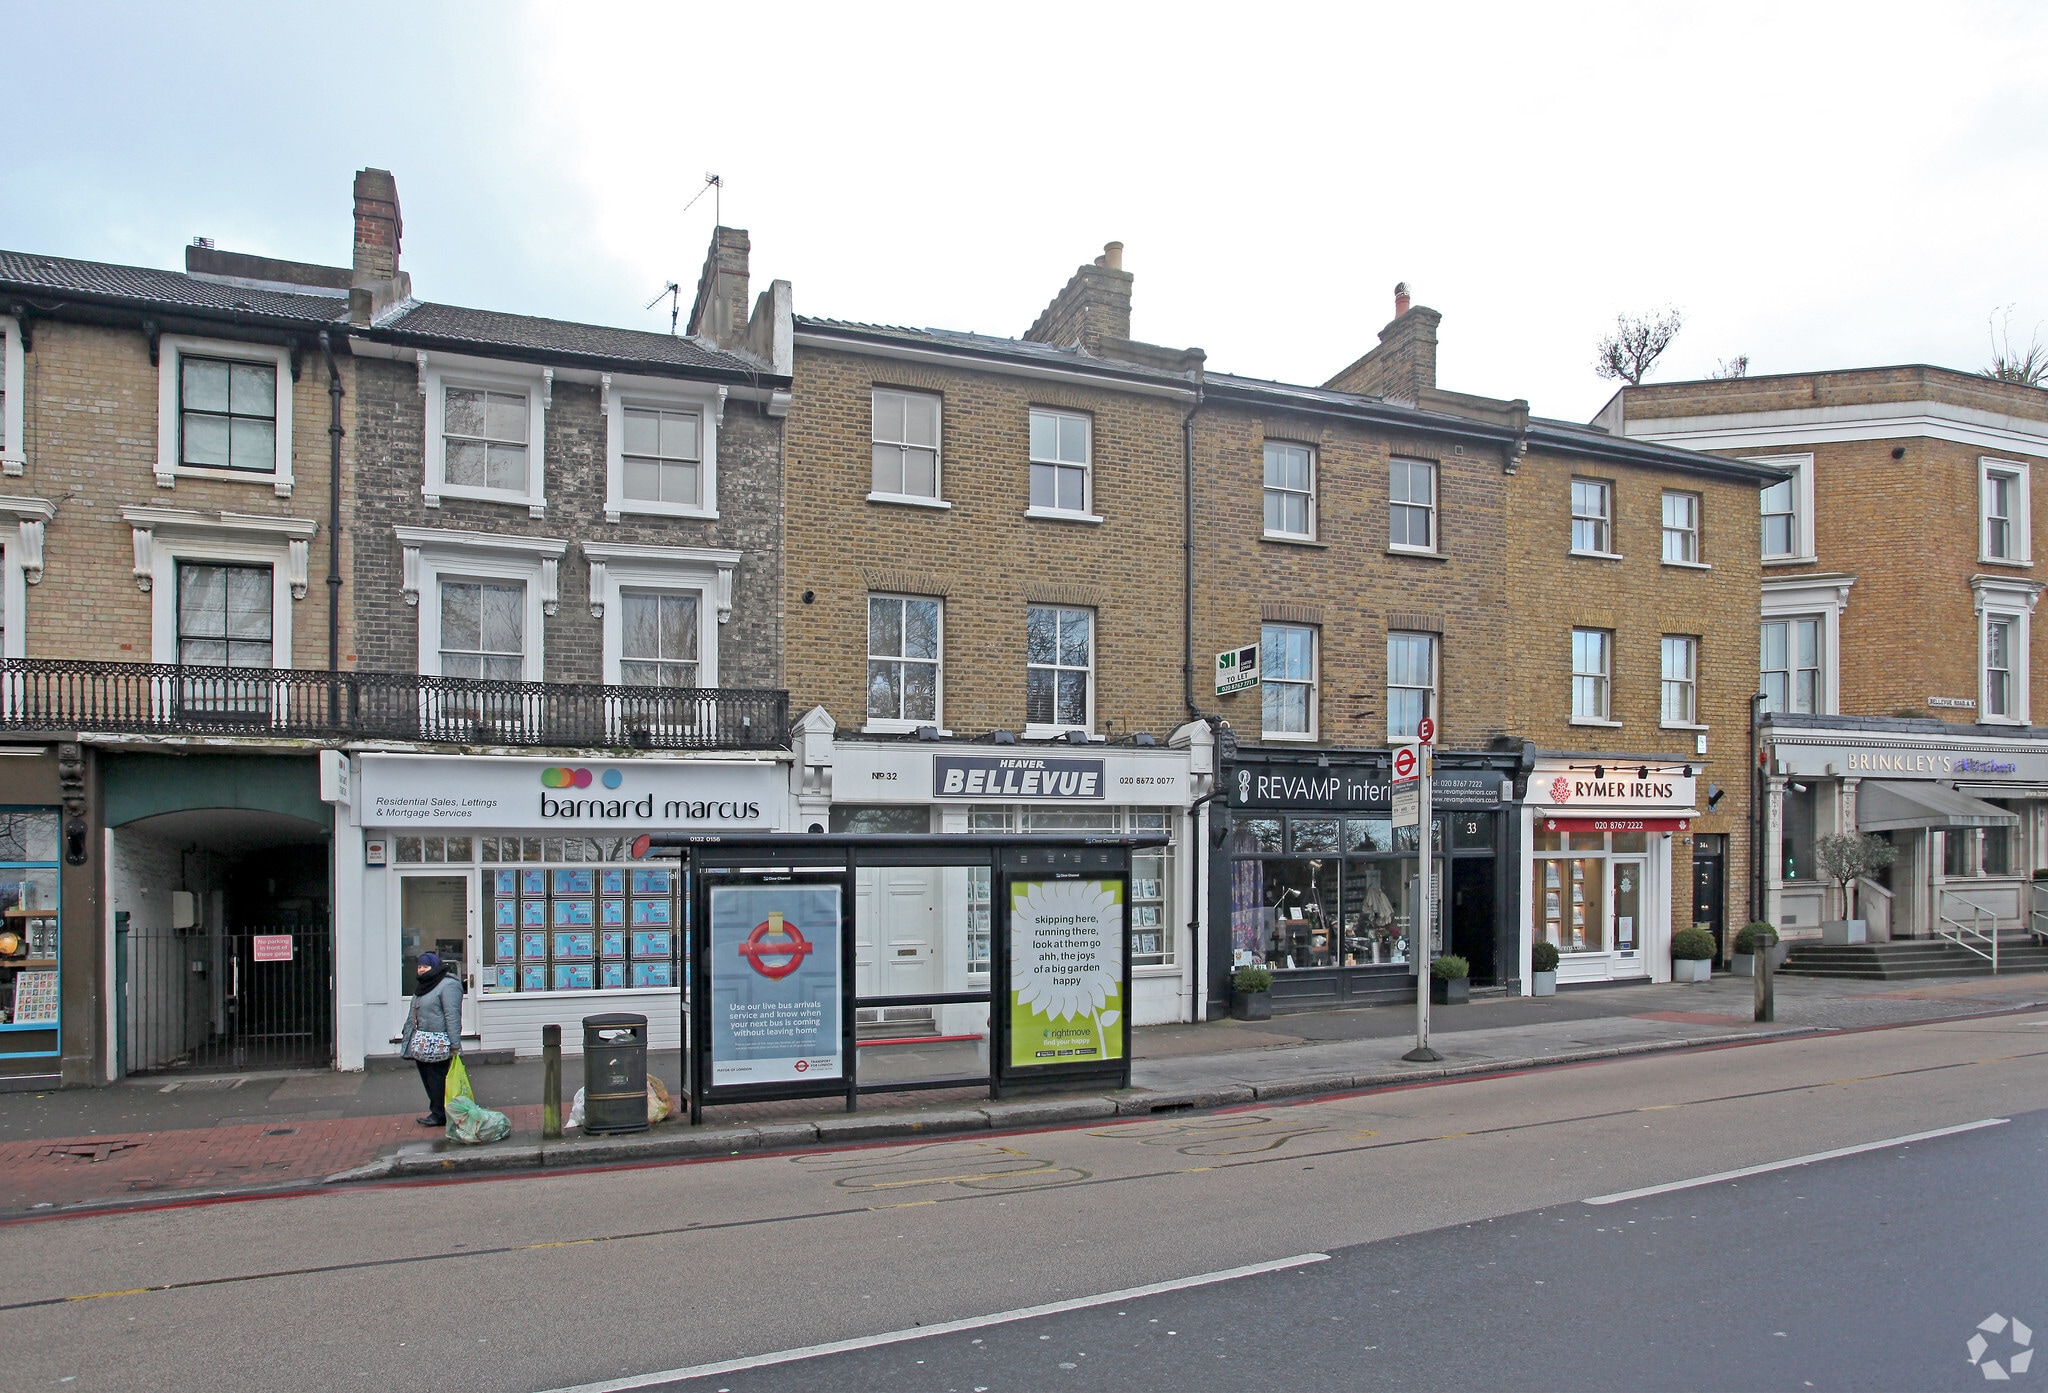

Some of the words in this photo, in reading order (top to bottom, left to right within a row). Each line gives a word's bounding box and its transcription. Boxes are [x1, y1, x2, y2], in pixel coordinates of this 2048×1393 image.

[1237, 672, 1248, 681] LET
[1422, 721, 1429, 737] E
[1000, 760, 1046, 769] HEAVER
[1848, 753, 1950, 772] BRINKLEY'S
[886, 772, 898, 780] 32
[1120, 776, 1134, 784] 020
[1156, 777, 1175, 785] 0077
[943, 769, 1098, 796] BELLEVUE
[1452, 780, 1468, 788] 8767
[1468, 780, 1482, 788] 7222
[1258, 776, 1341, 800] REVAMP
[1348, 778, 1392, 802] interi
[1576, 782, 1626, 798] RYMER
[1630, 783, 1673, 798] IRENS
[376, 797, 428, 806] Residential
[430, 798, 459, 807] Sales,
[462, 798, 498, 808] Lettings
[541, 791, 653, 818] barnard
[664, 800, 760, 818] marcus
[376, 808, 384, 816] &
[386, 808, 430, 818] Mortgage
[432, 808, 472, 818] Services
[1466, 822, 1477, 834] 33
[1594, 821, 1608, 830] 020
[1610, 822, 1626, 830] 8767
[1627, 822, 1644, 830] 2222
[1035, 915, 1074, 925] skipping
[1075, 915, 1098, 924] here,
[1035, 928, 1070, 937] running
[1072, 927, 1098, 936] there,
[1032, 940, 1052, 948] look
[1054, 940, 1062, 948] at
[1064, 940, 1088, 948] them
[1090, 940, 1100, 949] go
[1039, 953, 1059, 961] ahh,
[1061, 952, 1076, 960] the
[1076, 952, 1095, 961] joys
[1034, 965, 1043, 974] of
[1052, 964, 1066, 974] big
[1068, 964, 1100, 974] garden
[1053, 977, 1081, 986] happy
[762, 1002, 776, 1010] live
[794, 1000, 821, 1008] arrivals
[730, 1012, 758, 1020] service
[776, 1010, 798, 1018] know
[730, 1022, 748, 1030] your
[750, 1020, 768, 1028] next
[770, 1018, 784, 1026] bus
[784, 1018, 791, 1026] is
[792, 1018, 820, 1027] coming
[734, 1028, 765, 1037] without
[766, 1027, 794, 1036] leaving
[796, 1026, 818, 1034] home
[1052, 1029, 1090, 1038] rightmove
